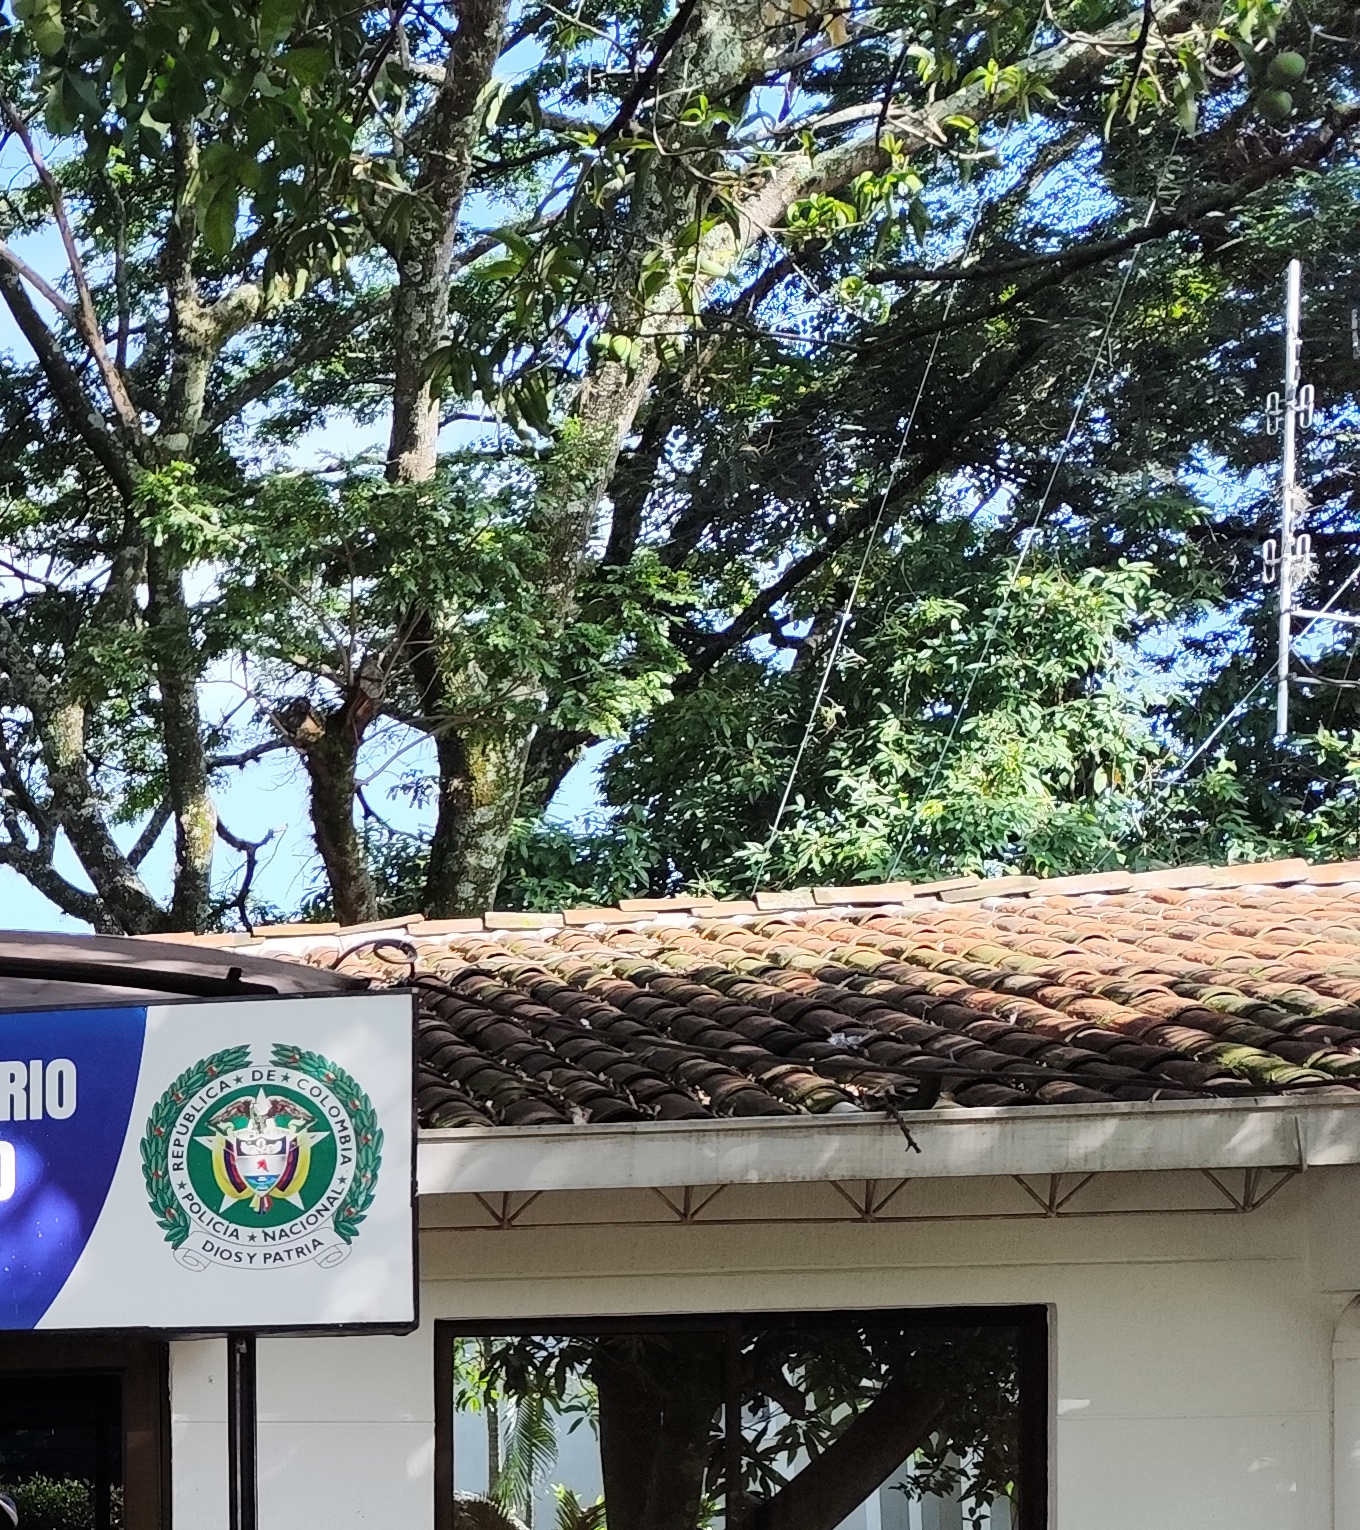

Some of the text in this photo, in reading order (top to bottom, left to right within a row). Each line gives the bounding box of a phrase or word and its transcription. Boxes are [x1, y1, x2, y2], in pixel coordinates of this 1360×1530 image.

[251, 1069, 277, 1082] DE
[296, 1078, 352, 1166] COLOMBIA
[262, 1186, 345, 1243] NACIONAL
[201, 1238, 325, 1265] DIOS Y PATRIA
